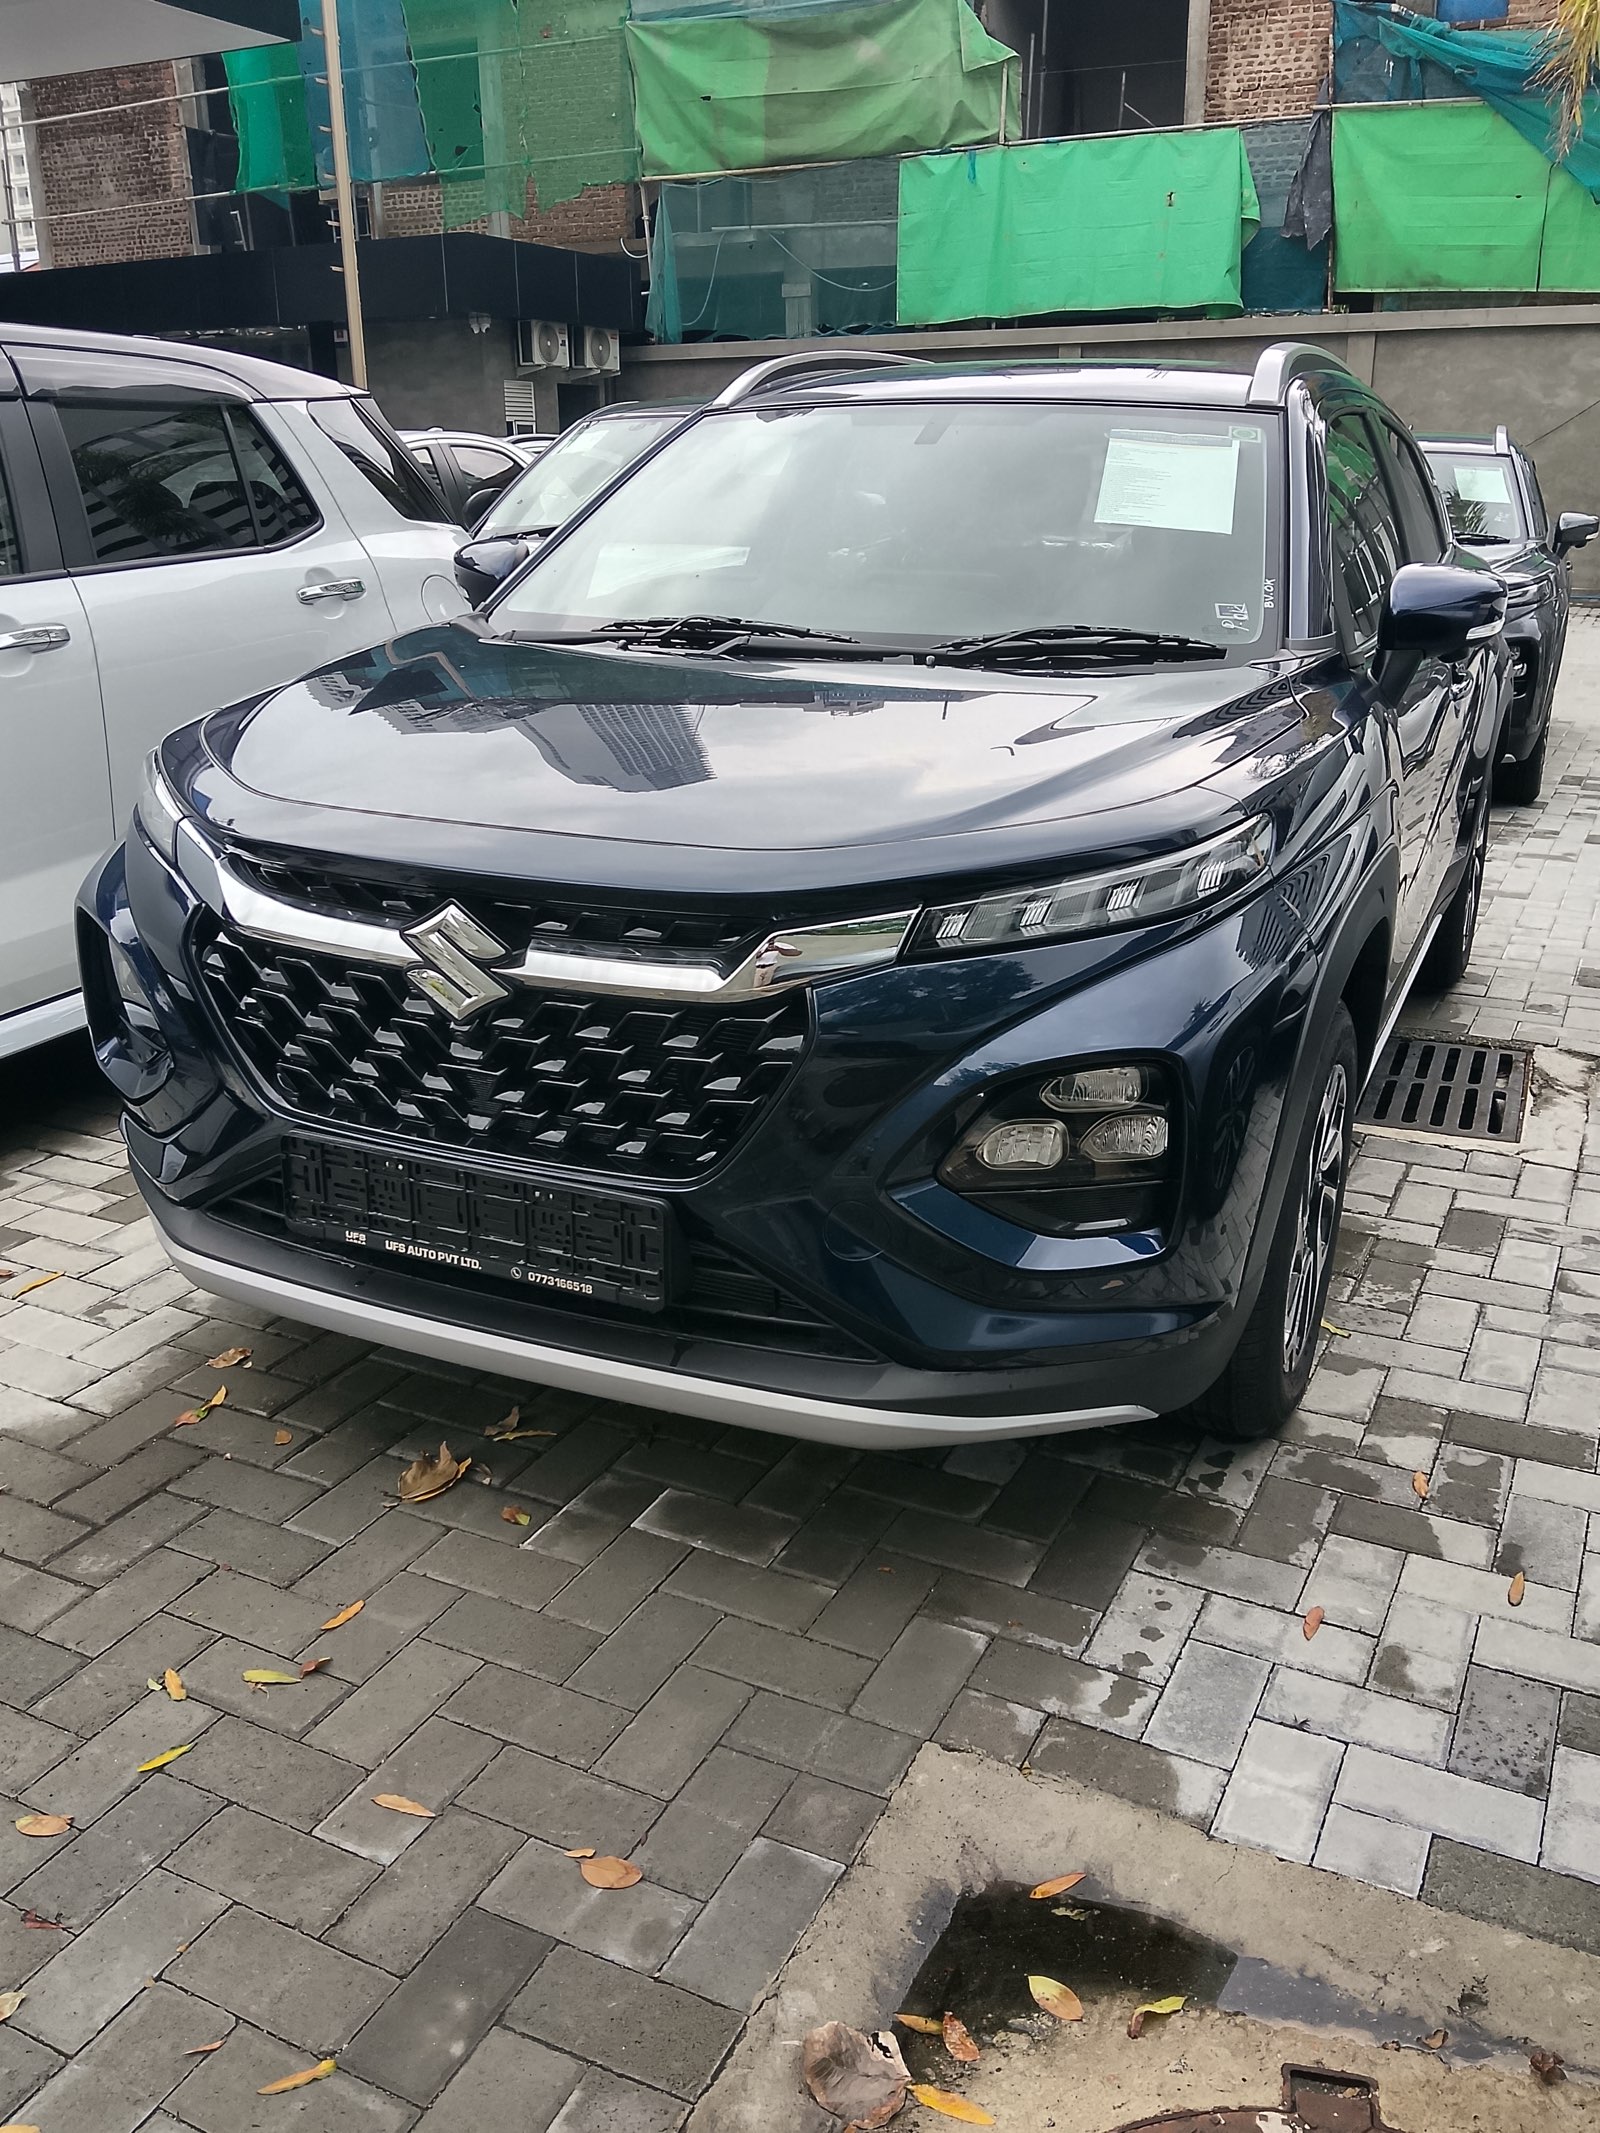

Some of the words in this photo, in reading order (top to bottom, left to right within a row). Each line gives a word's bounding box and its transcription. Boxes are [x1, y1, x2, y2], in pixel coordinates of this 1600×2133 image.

[385, 1240, 406, 1253] UFS
[406, 1245, 437, 1260] AUTO
[437, 1251, 460, 1265] PVT
[460, 1256, 482, 1270] LTD.
[527, 1271, 593, 1294] 0773166518
